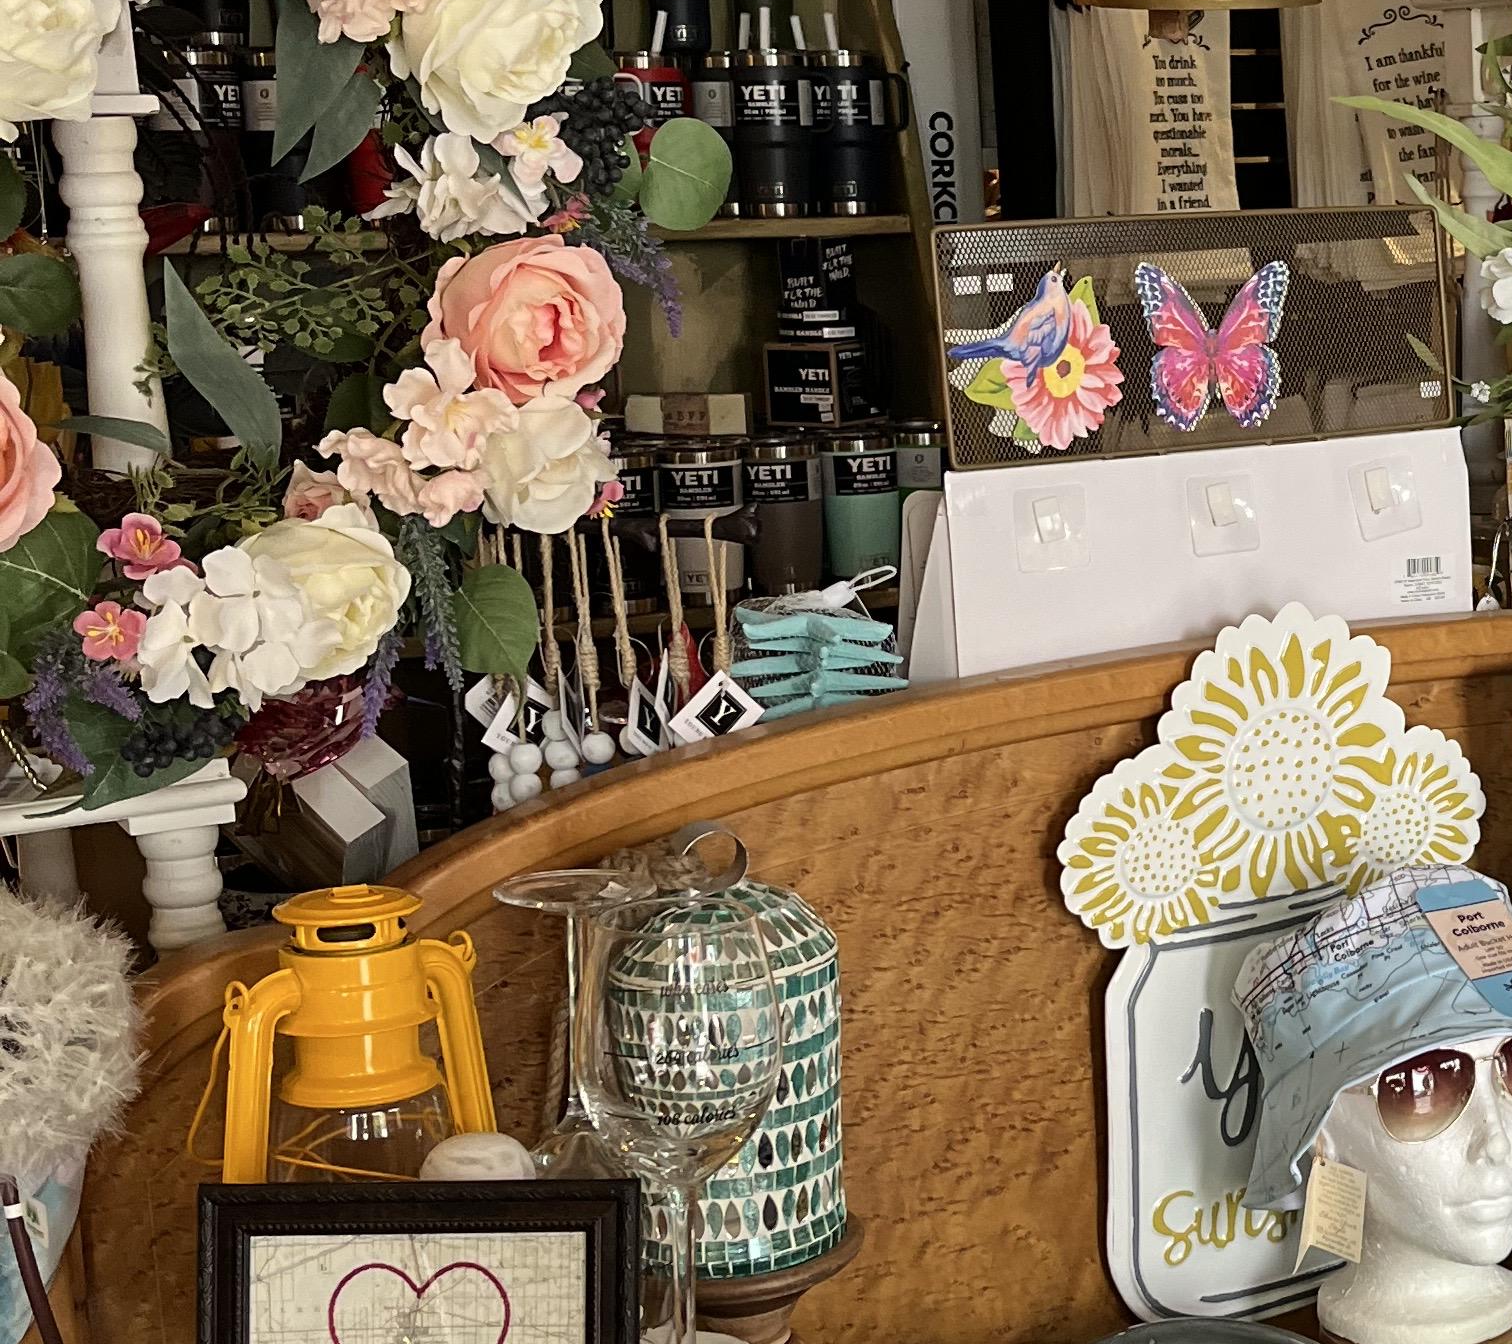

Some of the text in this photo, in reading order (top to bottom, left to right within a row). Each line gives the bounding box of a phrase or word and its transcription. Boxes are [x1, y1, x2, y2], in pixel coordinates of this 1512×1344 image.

[1169, 54, 1197, 70] drink
[1376, 56, 1397, 69] am
[1373, 69, 1441, 93] for the wine
[740, 84, 786, 101] YETI
[1170, 108, 1189, 123] You
[1169, 179, 1204, 193] wanted
[799, 368, 829, 382] YETI
[846, 455, 891, 473] YETI
[671, 470, 719, 486] YETI
[746, 464, 792, 481] YETI
[709, 697, 738, 726] Y
[1457, 910, 1485, 924] Port
[1452, 919, 1506, 938] Colborne
[1330, 940, 1350, 954] Port
[1333, 939, 1375, 963] Colborne
[1457, 939, 1480, 953] Adult
